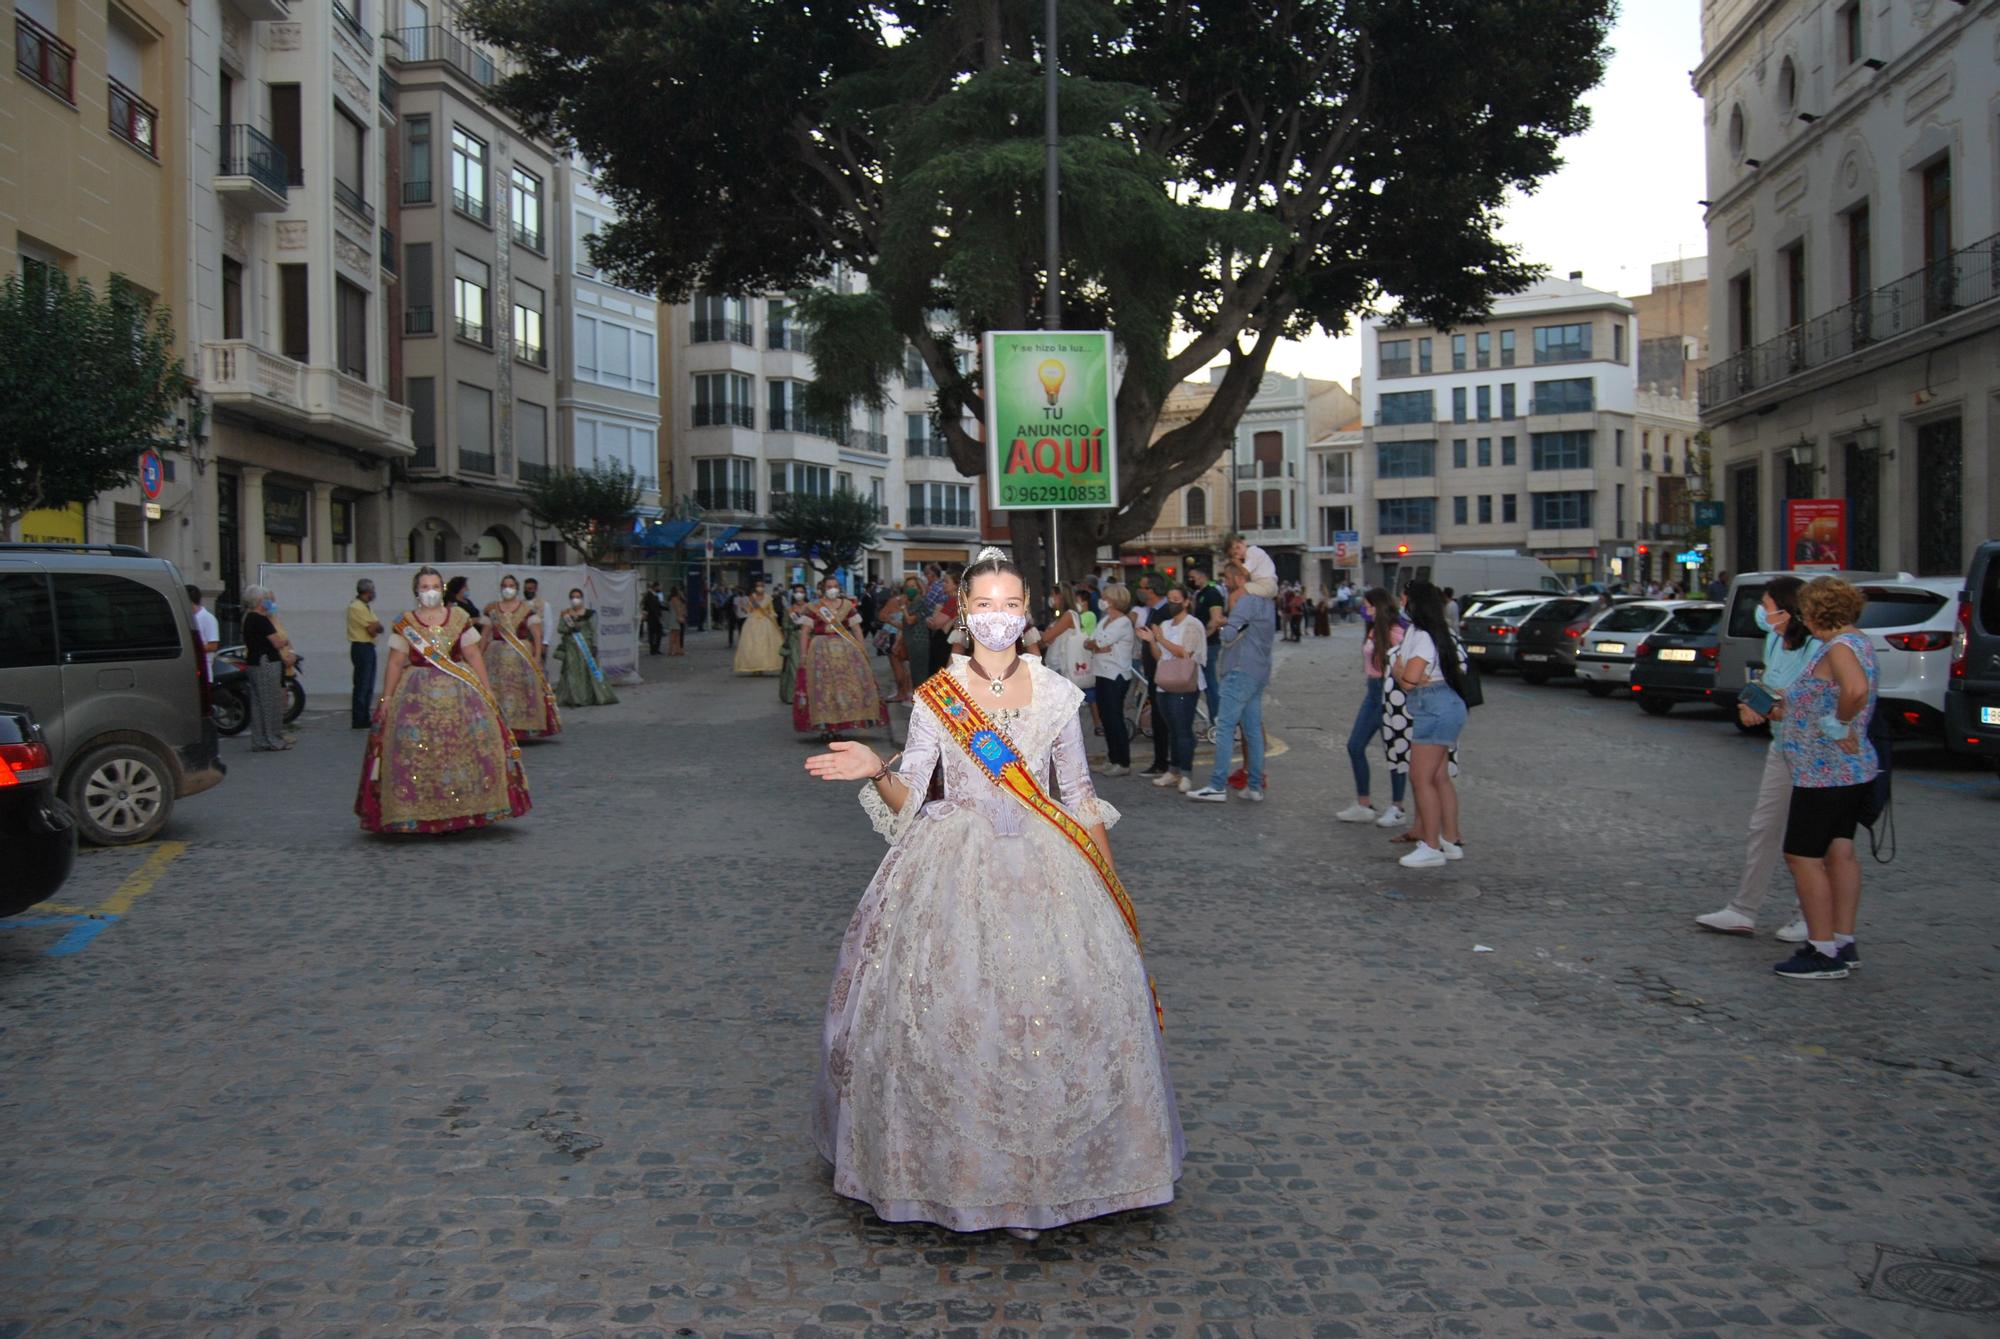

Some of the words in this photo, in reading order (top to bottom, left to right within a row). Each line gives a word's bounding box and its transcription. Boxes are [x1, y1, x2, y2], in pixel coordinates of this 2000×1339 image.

[1011, 344, 1018, 352] Y
[1036, 344, 1056, 352] hizo
[1059, 344, 1067, 352] la
[1043, 407, 1063, 420] TU
[1017, 424, 1090, 437] ANUNCIO
[1004, 427, 1105, 479] AQUÍ
[1019, 485, 1107, 502] 962910853
